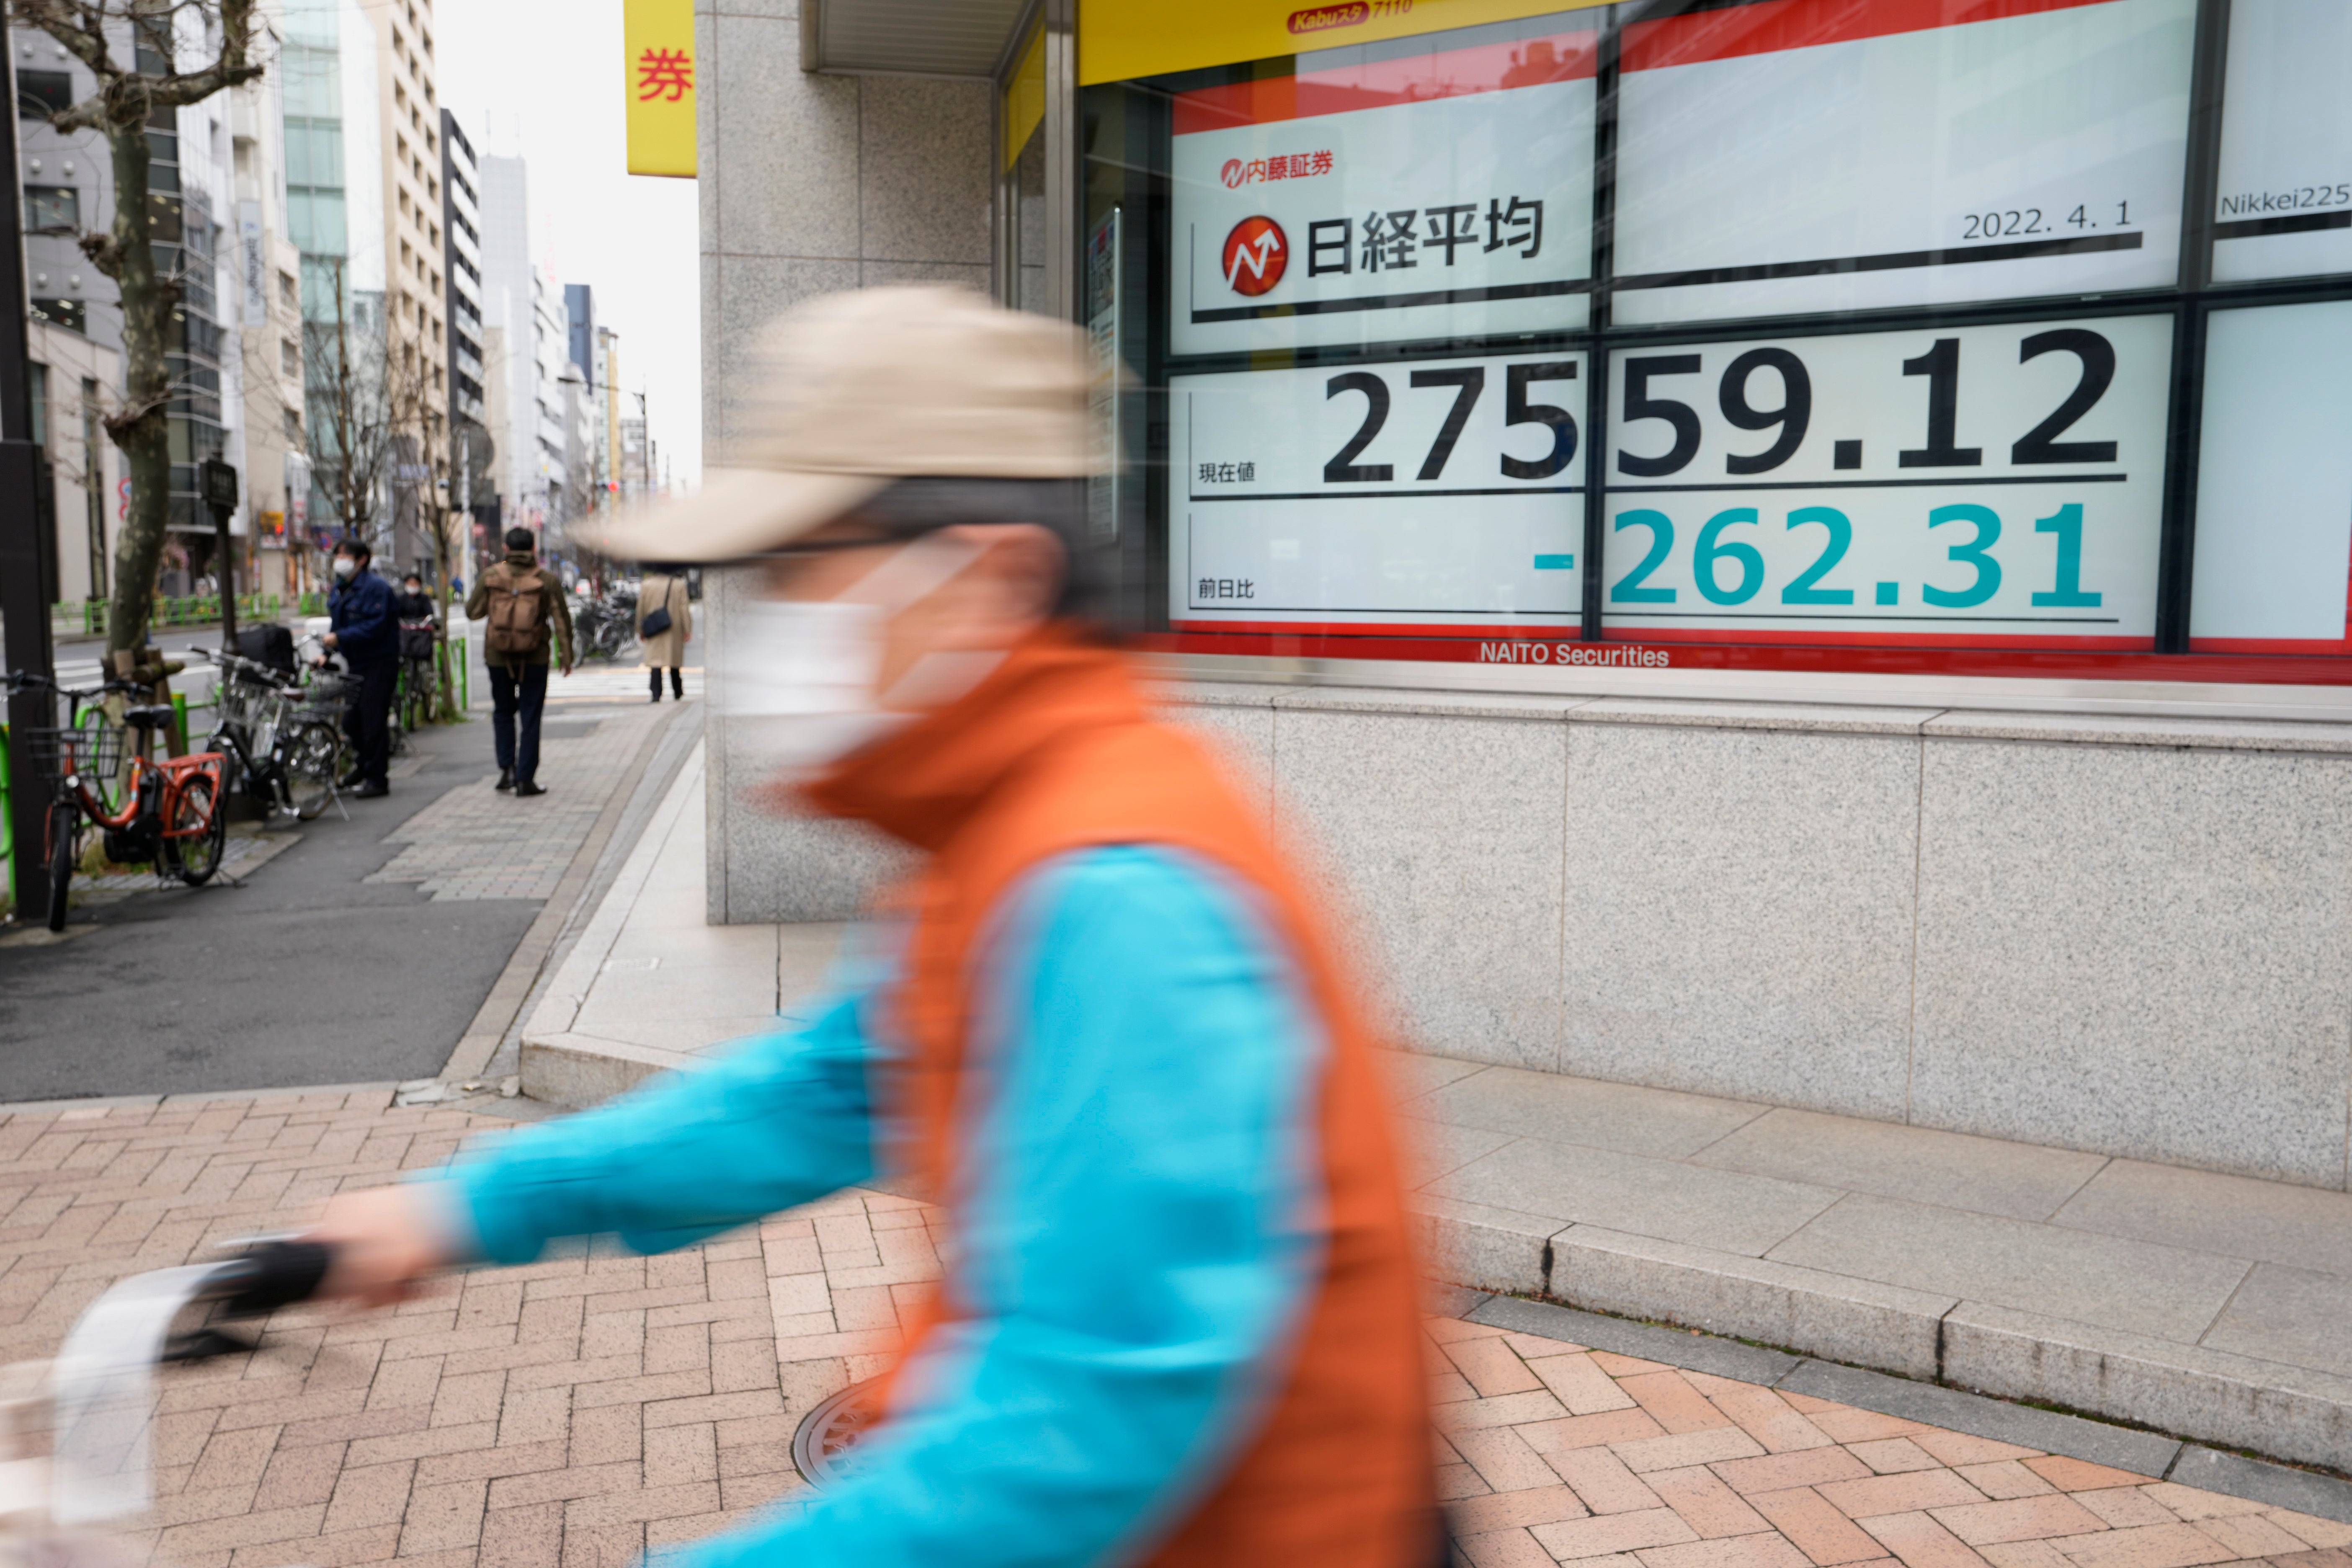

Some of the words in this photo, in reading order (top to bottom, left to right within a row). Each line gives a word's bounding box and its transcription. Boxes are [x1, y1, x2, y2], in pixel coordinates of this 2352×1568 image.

[1373, 0, 1413, 18] 7110
[638, 48, 693, 102] 券
[1246, 149, 1333, 184] 内藤証券
[2220, 184, 2350, 216] Nikkei225
[1307, 195, 1545, 279] 日経平均
[1199, 462, 1255, 483] 現在値
[1199, 578, 1254, 599] 前日比
[1480, 642, 1549, 663] NAITO
[1556, 644, 1669, 667] Securities
